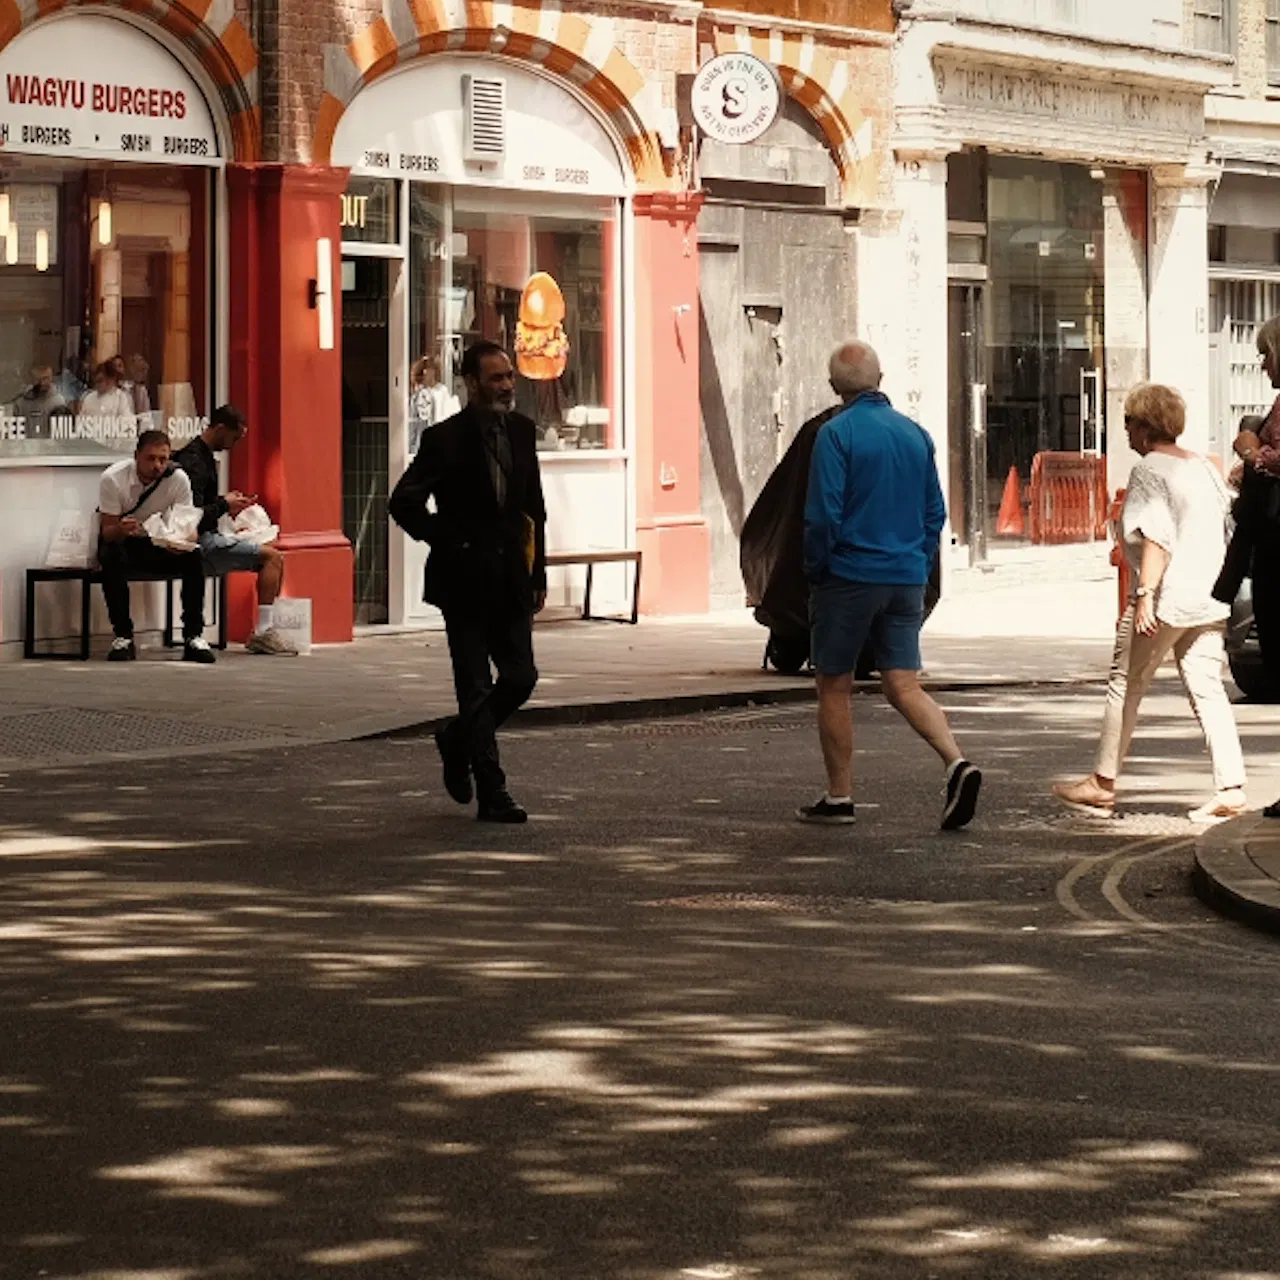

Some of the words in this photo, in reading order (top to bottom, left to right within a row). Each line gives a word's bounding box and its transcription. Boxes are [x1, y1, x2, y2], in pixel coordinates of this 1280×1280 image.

[7, 73, 85, 112] WAGYU
[92, 86, 187, 120] BURGERS
[721, 77, 749, 119] S
[22, 125, 71, 146] BURGERS
[163, 136, 208, 156] BURGERS
[399, 153, 440, 172] BURGERS
[555, 167, 589, 184] BURGERS
[50, 415, 137, 440] MILKSHAKES
